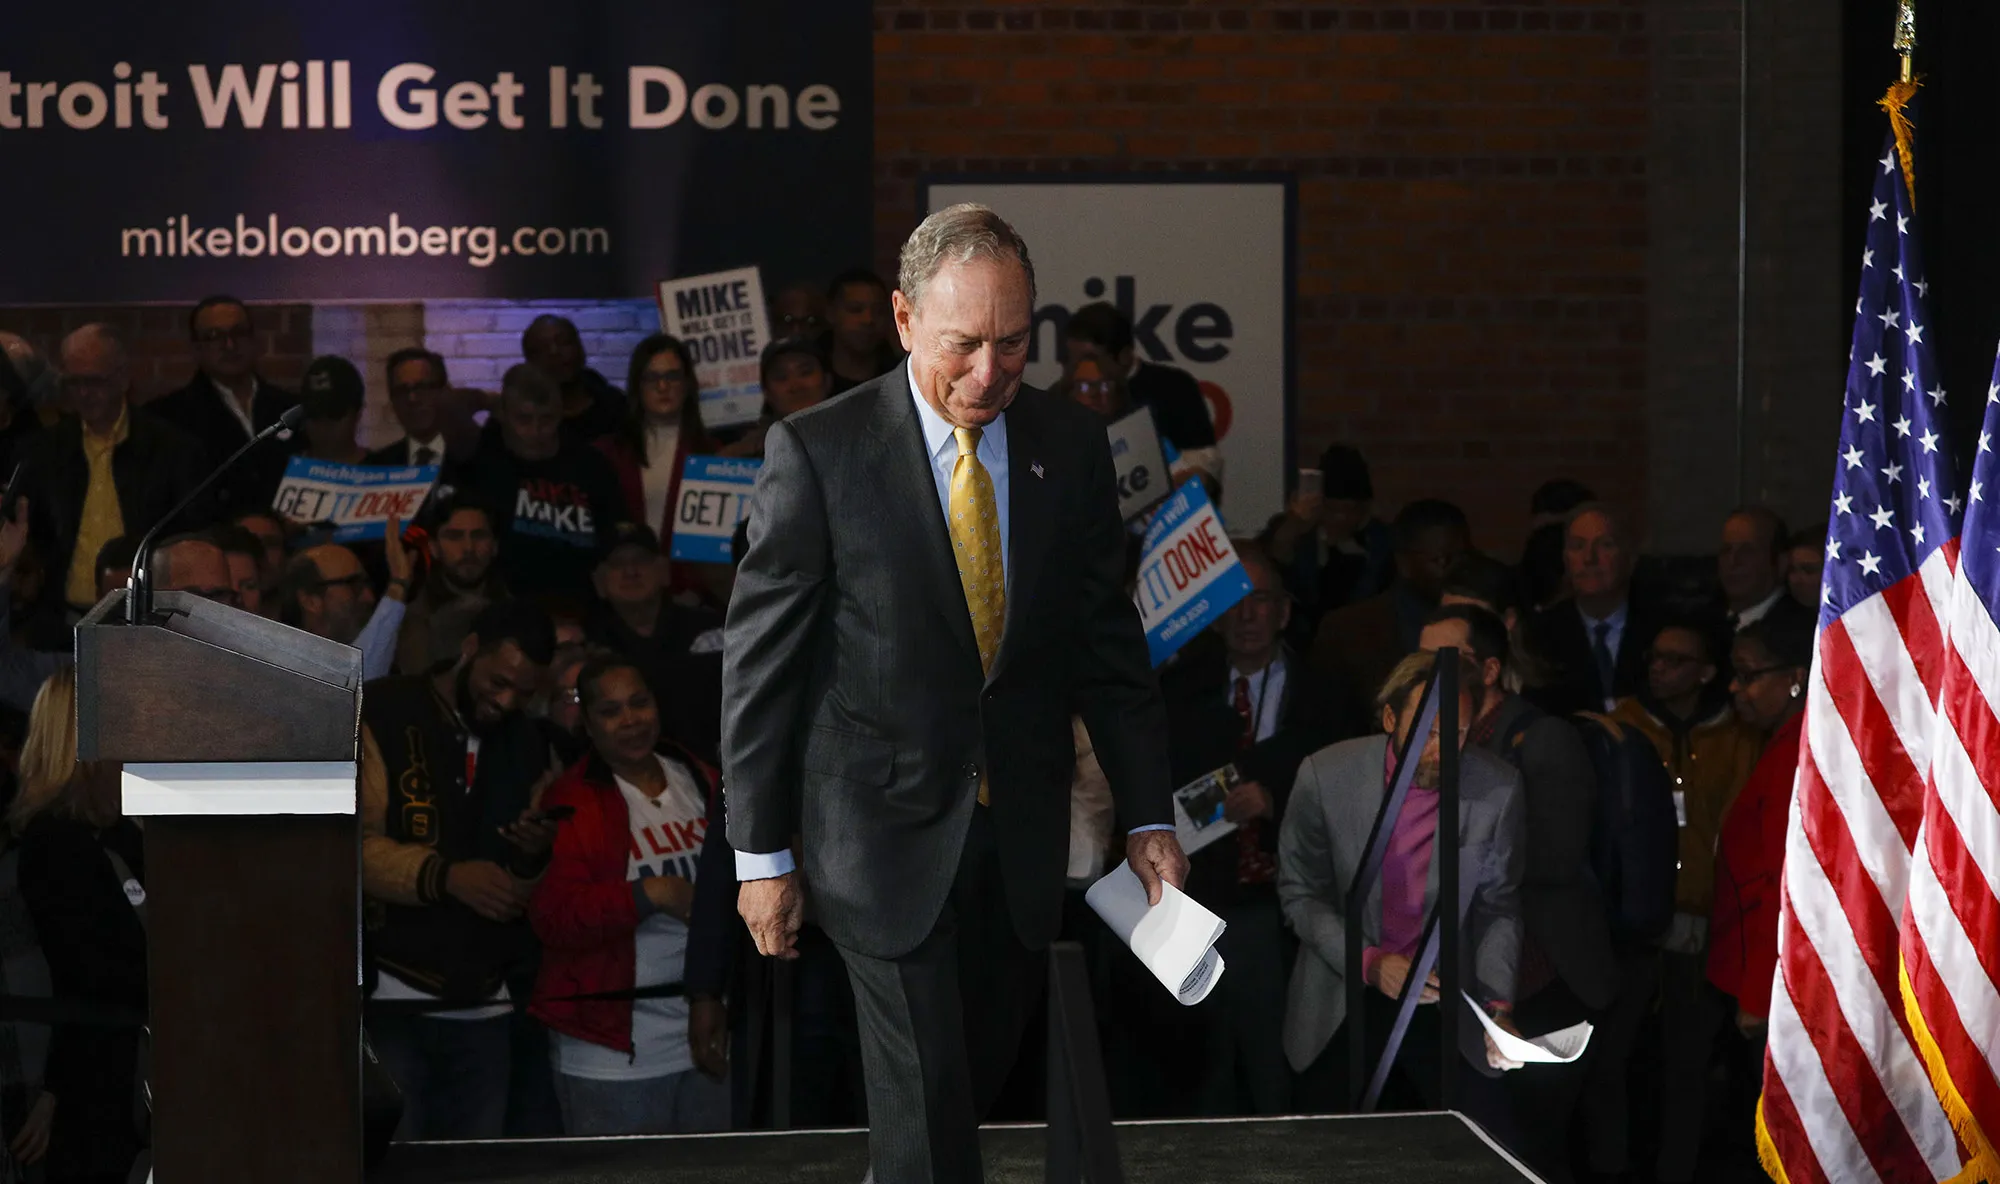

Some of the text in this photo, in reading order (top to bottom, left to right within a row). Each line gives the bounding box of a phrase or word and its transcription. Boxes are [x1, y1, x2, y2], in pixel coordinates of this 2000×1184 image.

[0, 60, 841, 130] troit Will Get It Done
[120, 213, 610, 268] mikebloomberg.com
[676, 280, 750, 319] MIKE
[1028, 275, 1233, 363] mke
[682, 320, 710, 335] WILL
[713, 314, 736, 329] GET
[308, 464, 386, 483] michigan
[278, 486, 330, 518] GET
[355, 489, 425, 518] DONE
[515, 488, 595, 533] MIKE
[680, 489, 732, 528] GET
[1143, 559, 1171, 610] IT
[1163, 516, 1228, 592] DONE
